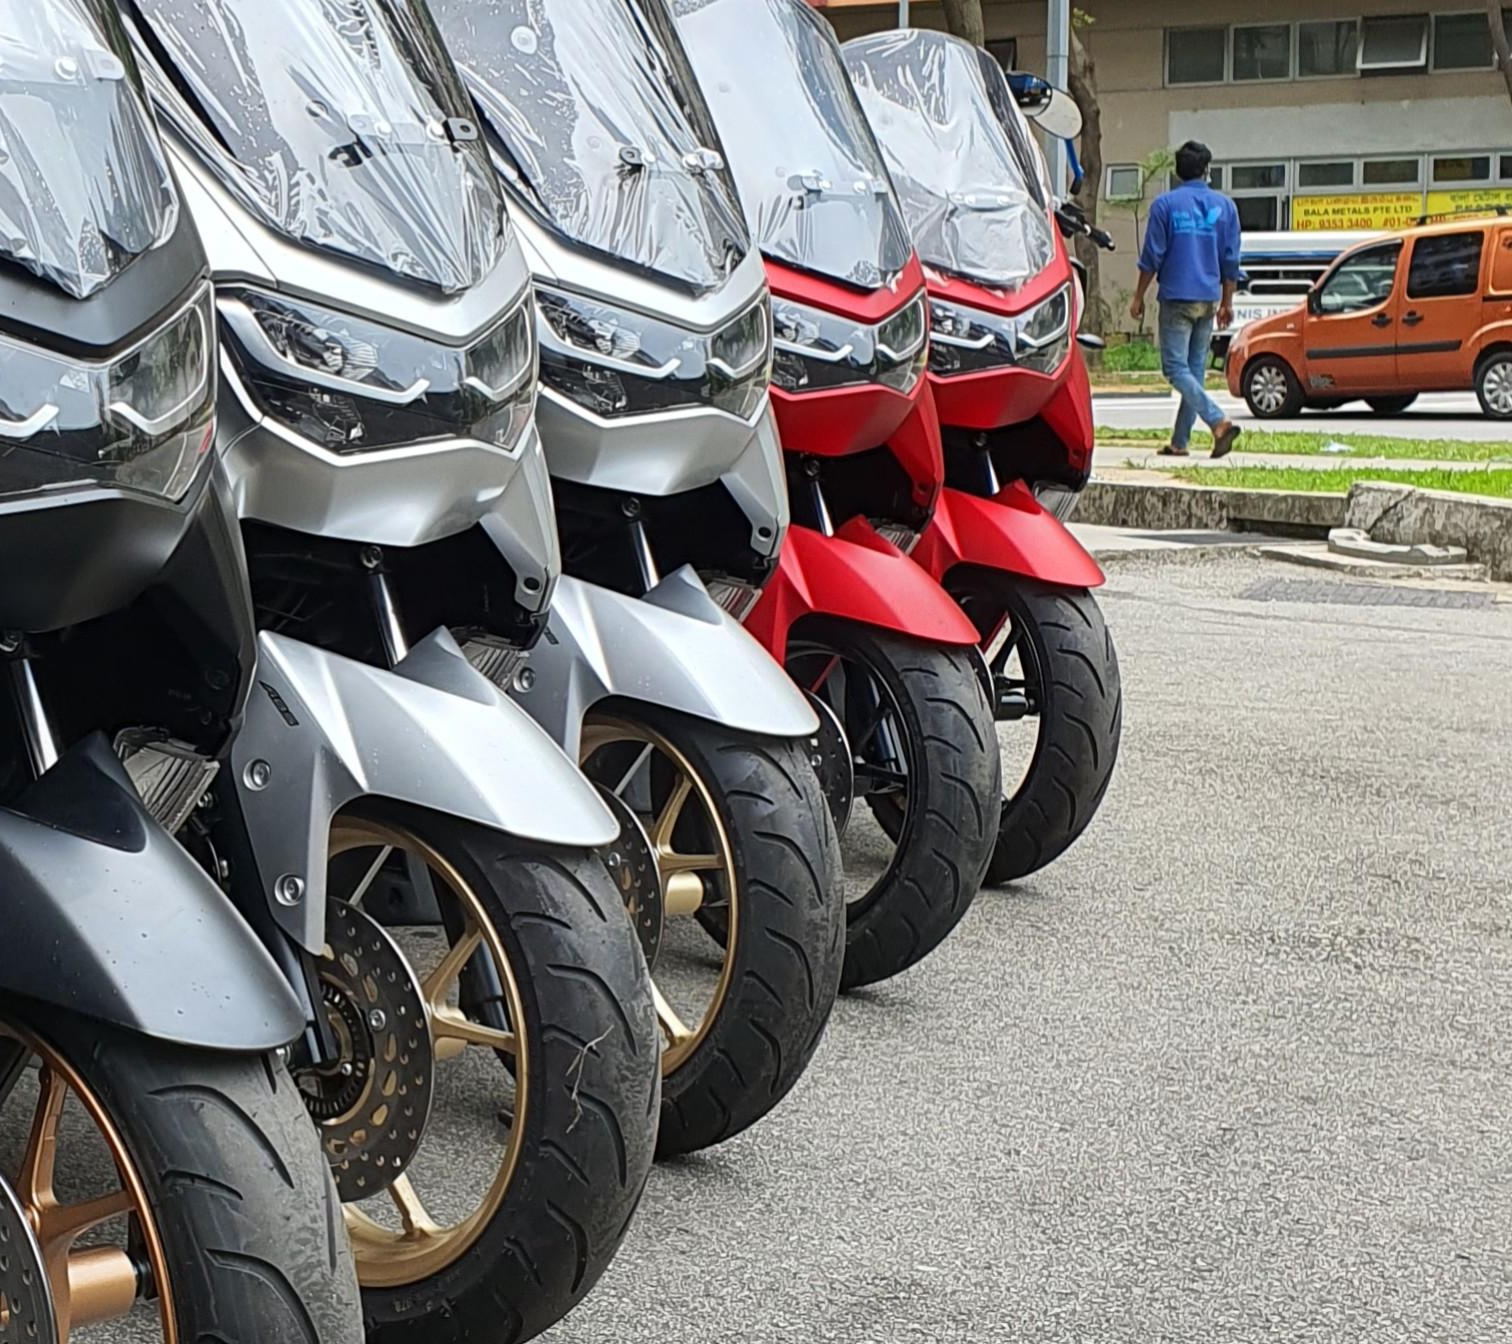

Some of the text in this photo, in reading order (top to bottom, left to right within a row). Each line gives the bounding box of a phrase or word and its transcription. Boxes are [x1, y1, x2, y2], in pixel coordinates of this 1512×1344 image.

[1303, 204, 1413, 217] BALA METALS PTE LTD
